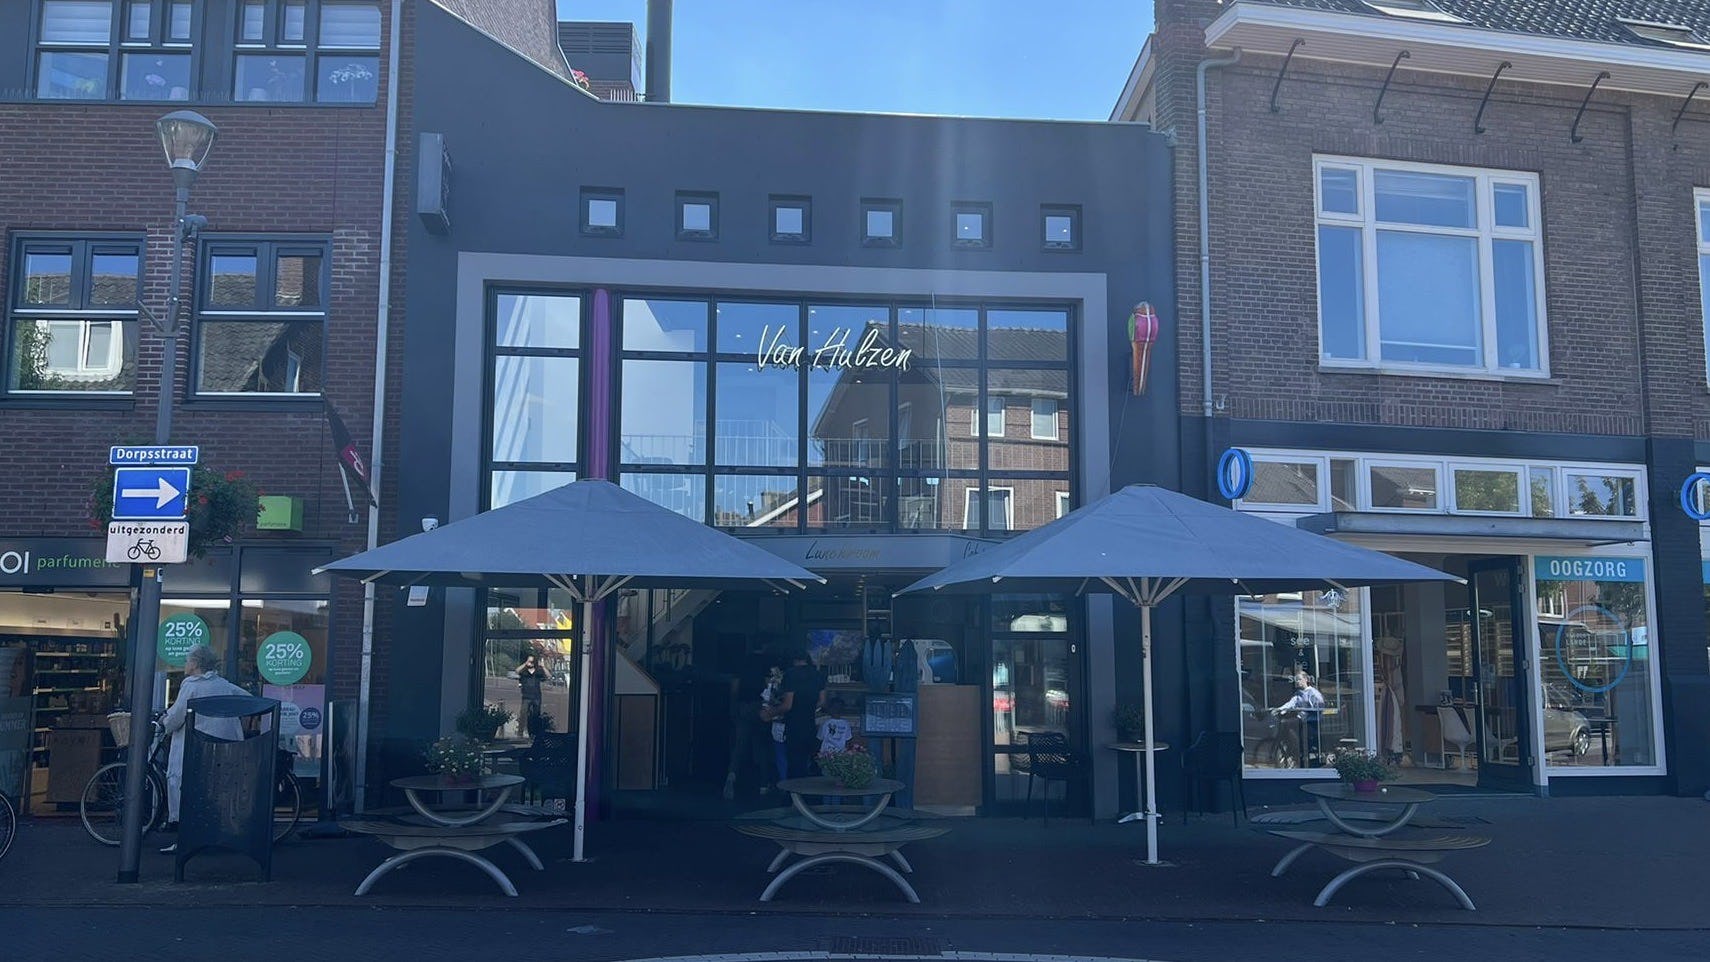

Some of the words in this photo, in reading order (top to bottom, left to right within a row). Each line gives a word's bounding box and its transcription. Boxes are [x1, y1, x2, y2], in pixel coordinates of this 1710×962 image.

[757, 324, 804, 368] Van
[812, 327, 912, 371] Hulzen
[116, 448, 193, 461] Dorpsstraat
[110, 525, 185, 536] uitgezonderd
[1550, 559, 1627, 577] OOGZORG
[165, 621, 203, 637] 25%
[165, 637, 201, 645] KORTING
[265, 643, 304, 659] 25%
[266, 659, 303, 667] KORTING
